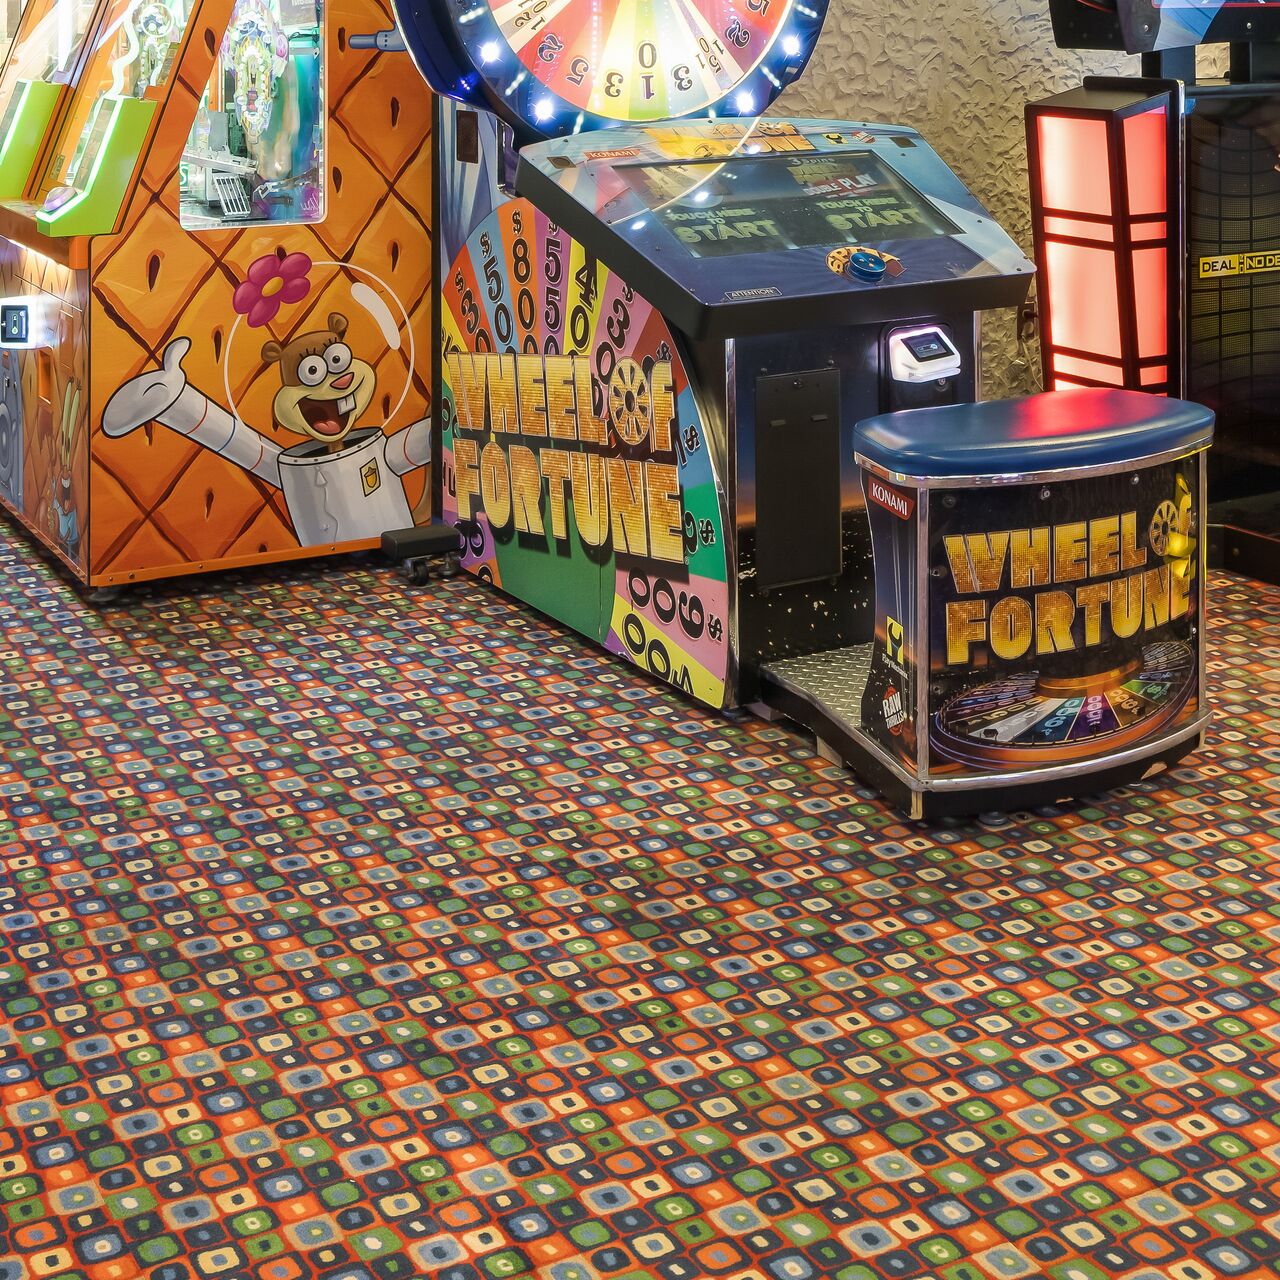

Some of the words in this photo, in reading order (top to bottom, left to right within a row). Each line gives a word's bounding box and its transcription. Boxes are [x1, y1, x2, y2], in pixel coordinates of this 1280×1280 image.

[588, 150, 638, 160] KONAMI
[841, 174, 878, 191] PLAY
[816, 199, 855, 210] TOUCH
[856, 206, 873, 214] TO
[674, 220, 777, 243] START
[825, 209, 921, 231] START
[1202, 259, 1236, 273] DEAL
[1246, 256, 1264, 269] NO
[448, 352, 609, 446] WHEEL
[452, 437, 685, 564] FORTUNE
[871, 483, 909, 517] KONAMI
[942, 511, 1149, 595] WHEEL
[944, 554, 1195, 667] FORTUNE
[882, 691, 903, 716] RAW
